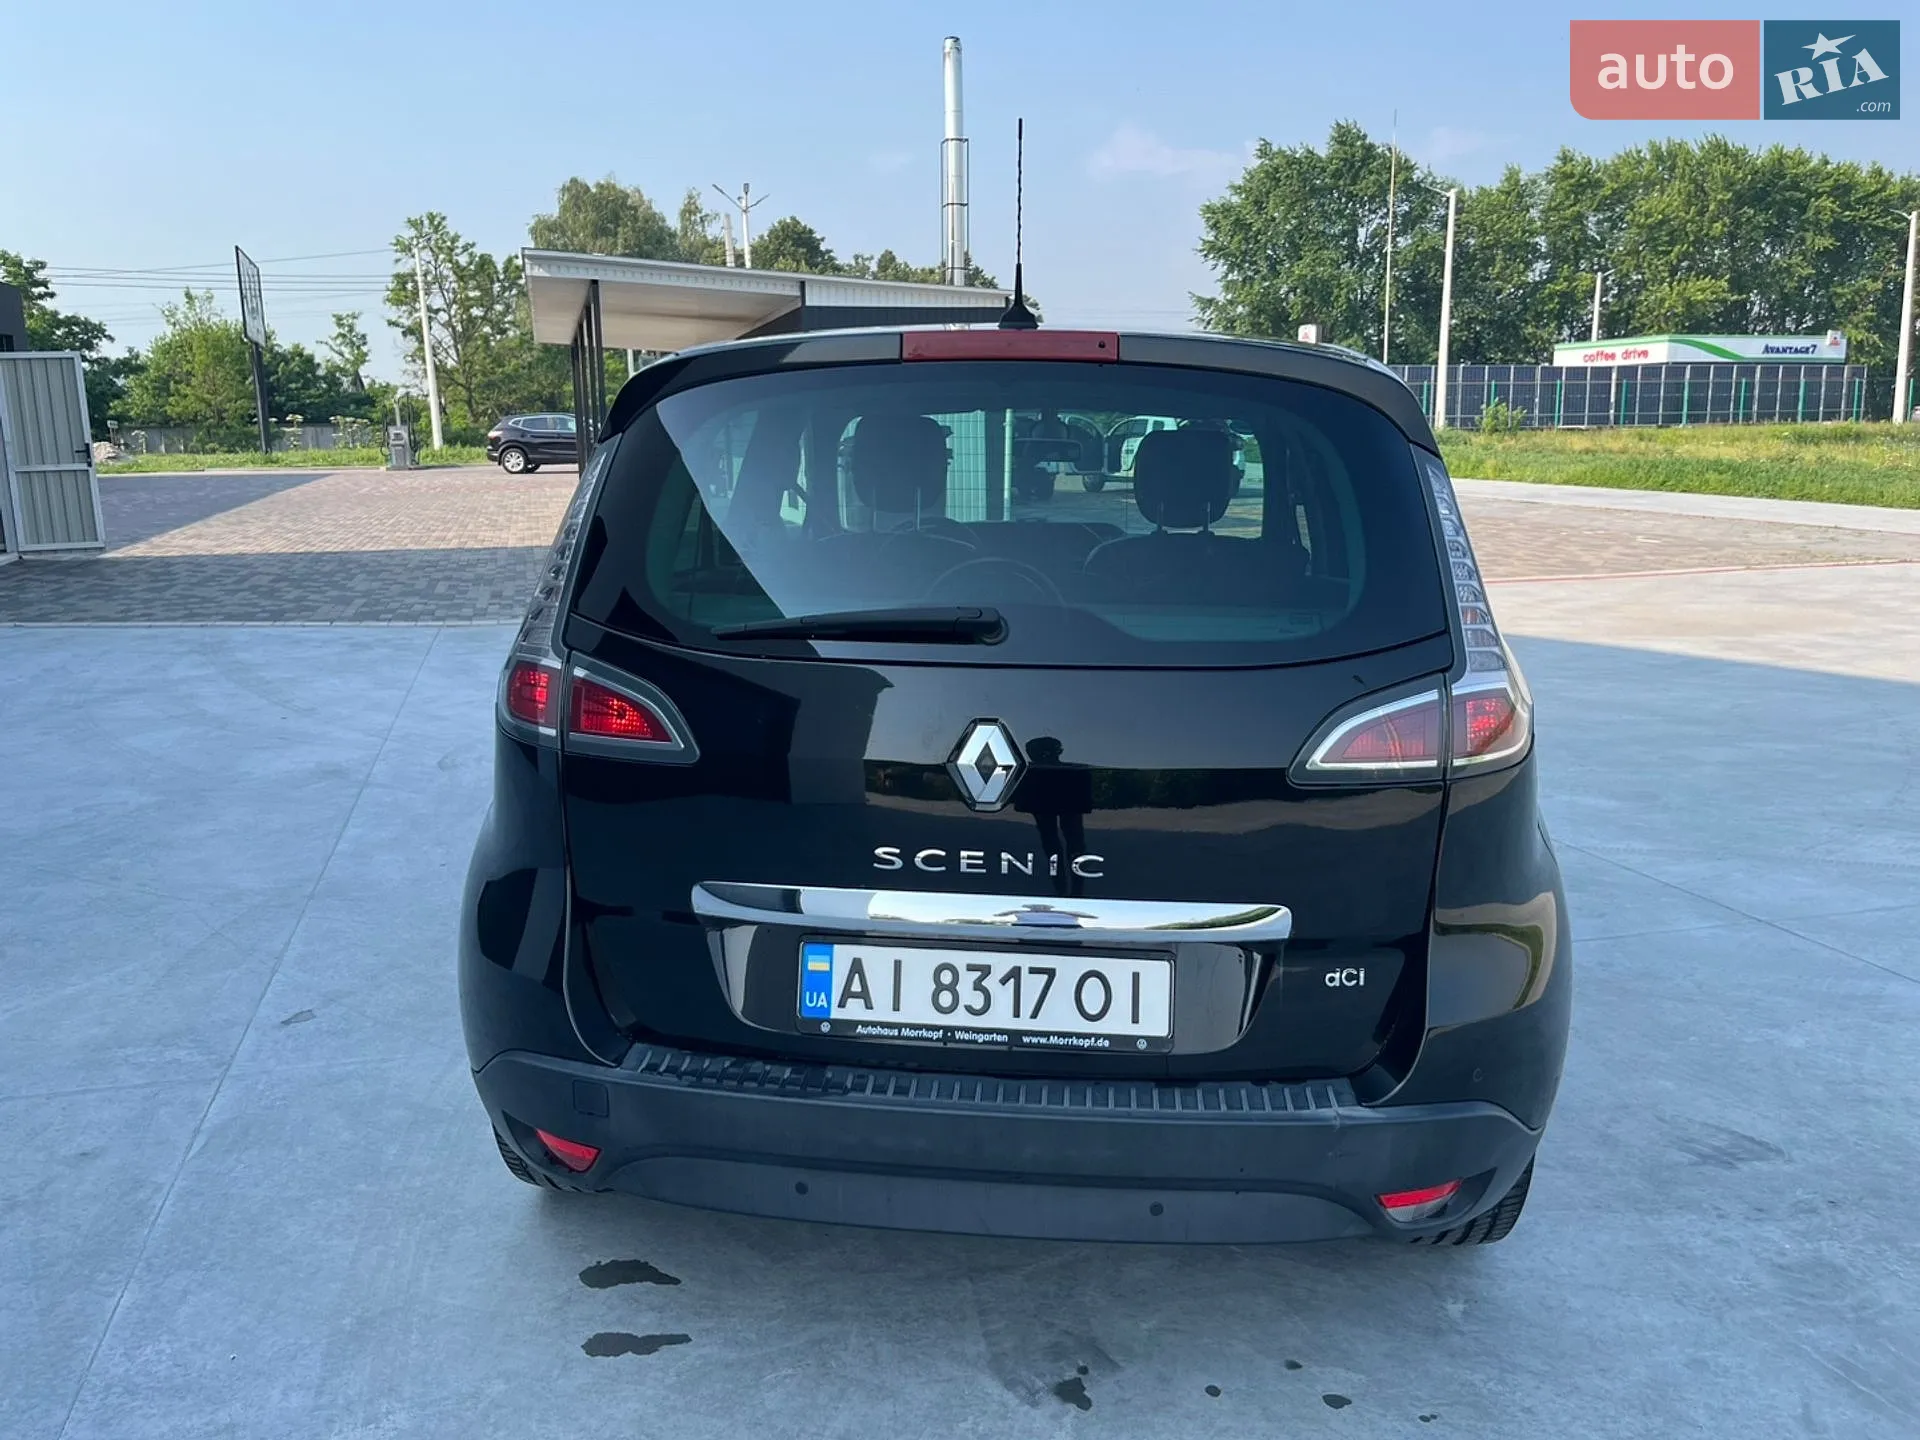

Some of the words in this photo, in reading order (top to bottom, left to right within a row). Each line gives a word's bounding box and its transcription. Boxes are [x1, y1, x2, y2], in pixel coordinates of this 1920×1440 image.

[1583, 350, 1617, 363] coffee
[1621, 348, 1649, 360] drive
[873, 847, 1104, 878] SCENIC
[1325, 968, 1365, 988] dCi
[805, 991, 828, 1009] UA
[837, 957, 903, 1012] AI
[931, 961, 1057, 1019] 8317
[1074, 969, 1140, 1024] OI
[856, 1024, 899, 1037] Autohaus
[900, 1027, 944, 1040] Morrkopf
[954, 1030, 1009, 1044] Weingarten
[1022, 1034, 1111, 1049] www.Morrkopf.de
